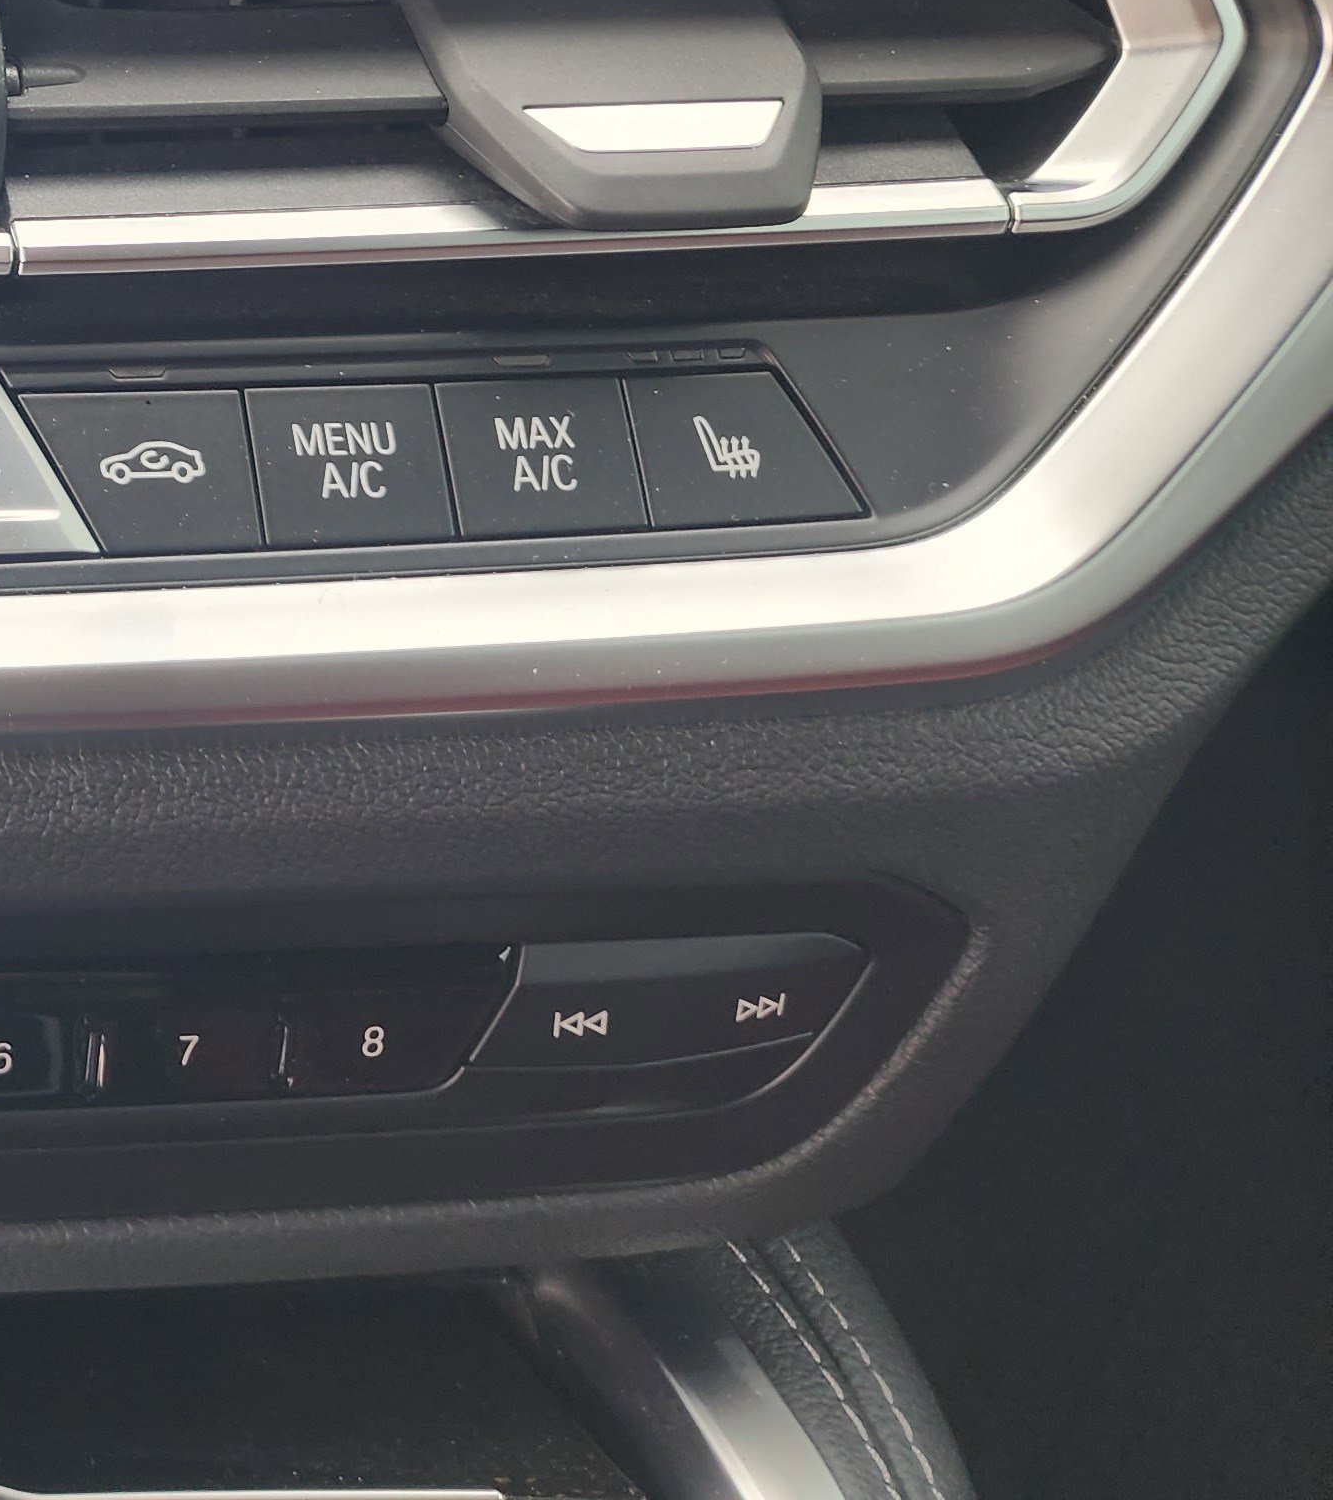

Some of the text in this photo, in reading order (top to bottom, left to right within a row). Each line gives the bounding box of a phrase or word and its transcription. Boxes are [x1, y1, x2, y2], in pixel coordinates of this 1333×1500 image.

[291, 421, 397, 457] MENU
[494, 415, 576, 450] MAX
[321, 460, 387, 499] A/C
[513, 453, 578, 492] A/C
[178, 1034, 200, 1066] 7
[361, 1025, 385, 1057] 8
